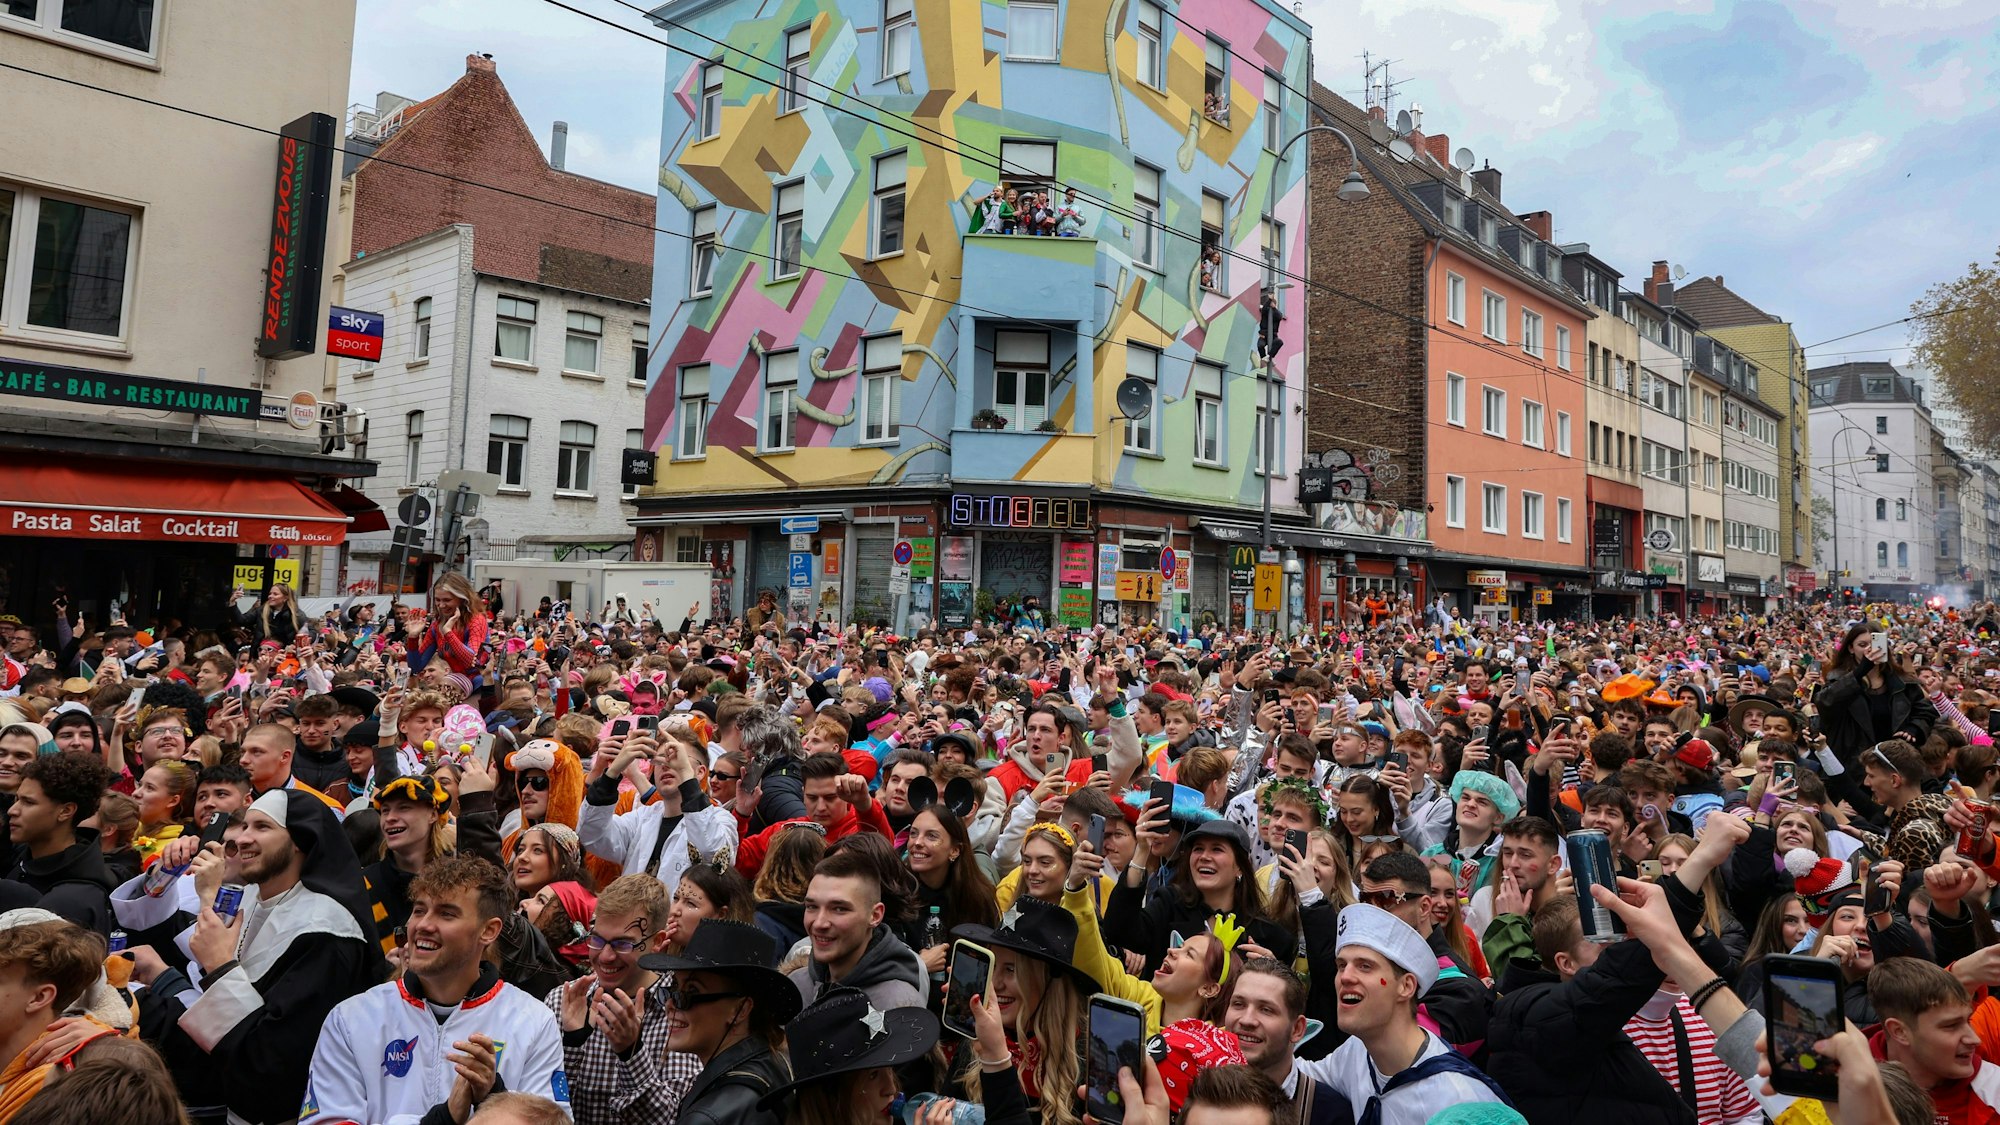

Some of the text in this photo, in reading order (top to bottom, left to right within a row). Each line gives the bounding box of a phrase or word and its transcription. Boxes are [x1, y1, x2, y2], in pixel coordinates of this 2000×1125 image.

[286, 256, 295, 277] BAR
[291, 145, 305, 238] RESTAURANT
[265, 137, 297, 341] RENDEZVOUS
[341, 313, 370, 333] sky
[336, 337, 371, 352] sport
[67, 378, 106, 399] BAR
[126, 385, 250, 414] RESTAURANT
[954, 500, 1087, 526] STIEFEL
[12, 511, 73, 531] Pasta
[89, 514, 142, 533] Salat
[162, 518, 239, 538] Cocktail
[793, 555, 803, 569] P
[1262, 570, 1275, 580] U1
[1650, 577, 1665, 590] sky
[942, 583, 970, 591] SMASH
[386, 1052, 411, 1062] NASA
